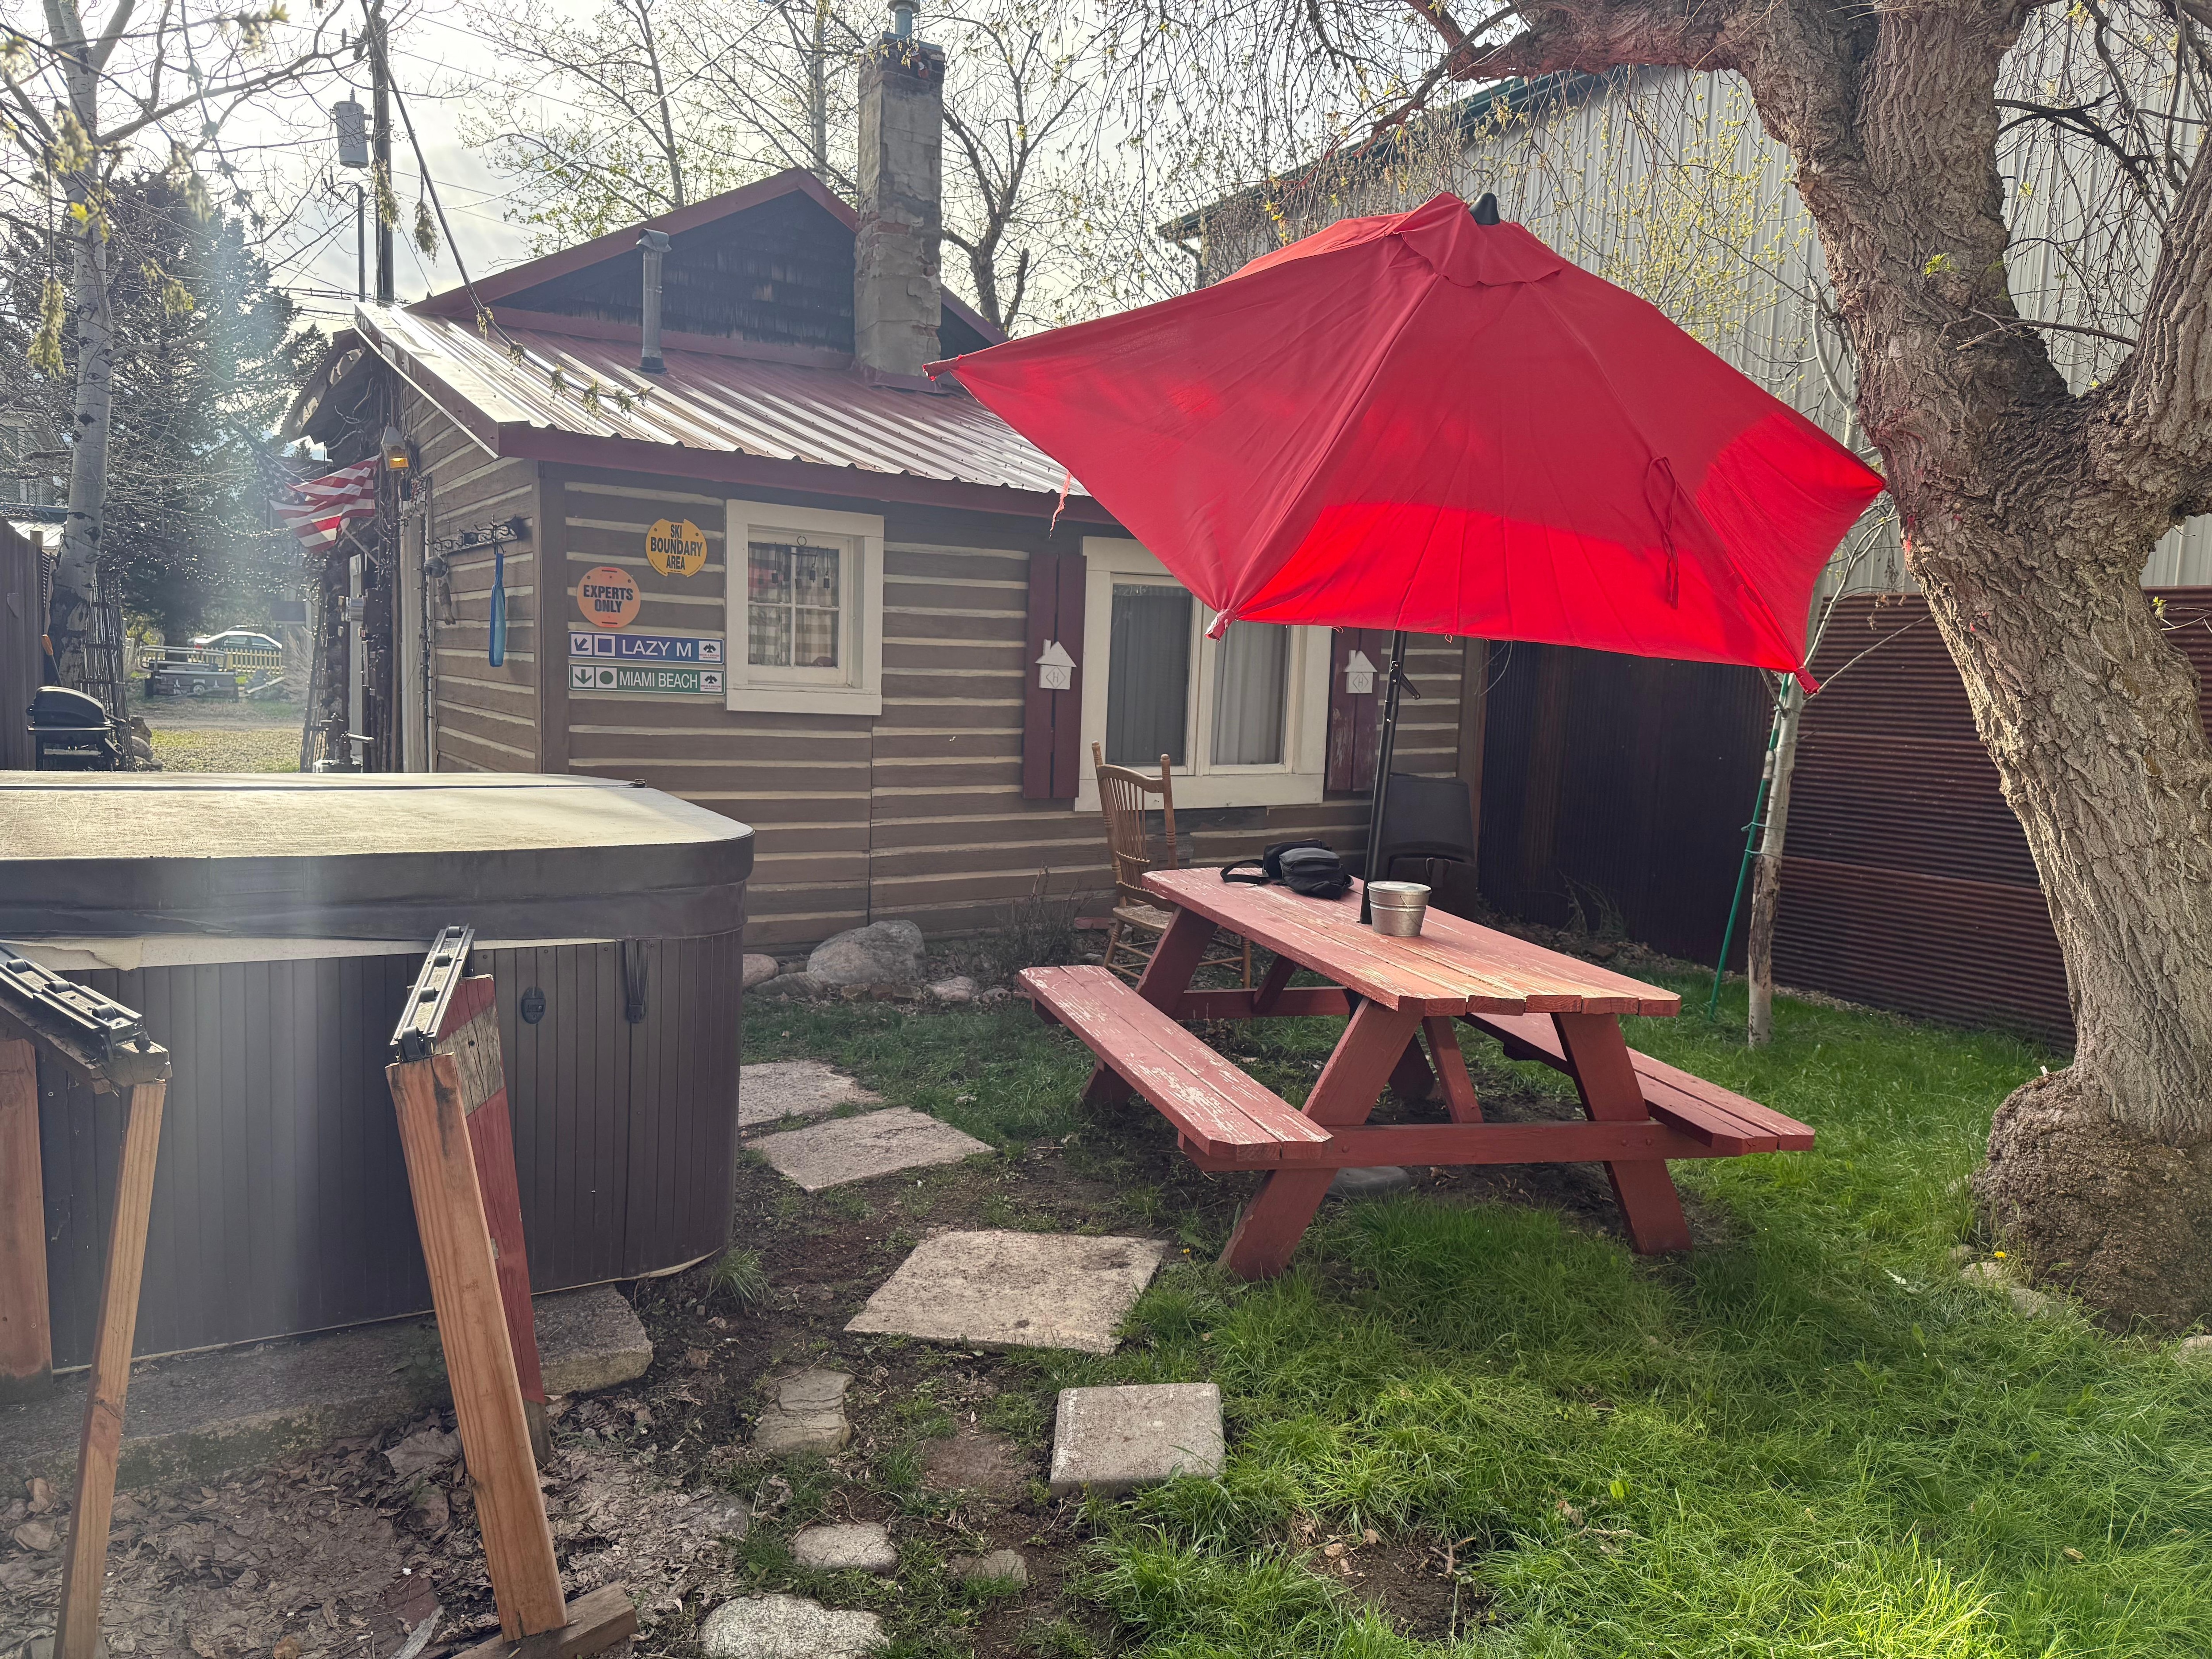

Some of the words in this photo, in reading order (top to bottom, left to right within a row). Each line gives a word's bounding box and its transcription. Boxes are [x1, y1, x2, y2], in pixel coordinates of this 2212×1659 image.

[670, 524, 682, 539] SKI
[651, 536, 703, 557] BOUNDARY
[666, 555, 685, 570] AREA
[583, 584, 634, 601] EXPERTS
[595, 599, 622, 613] ONLY
[622, 639, 671, 656] LAZY
[676, 642, 691, 657] M
[620, 671, 655, 687] MIAMI
[658, 672, 698, 688] BEACH
[1053, 671, 1059, 683] H
